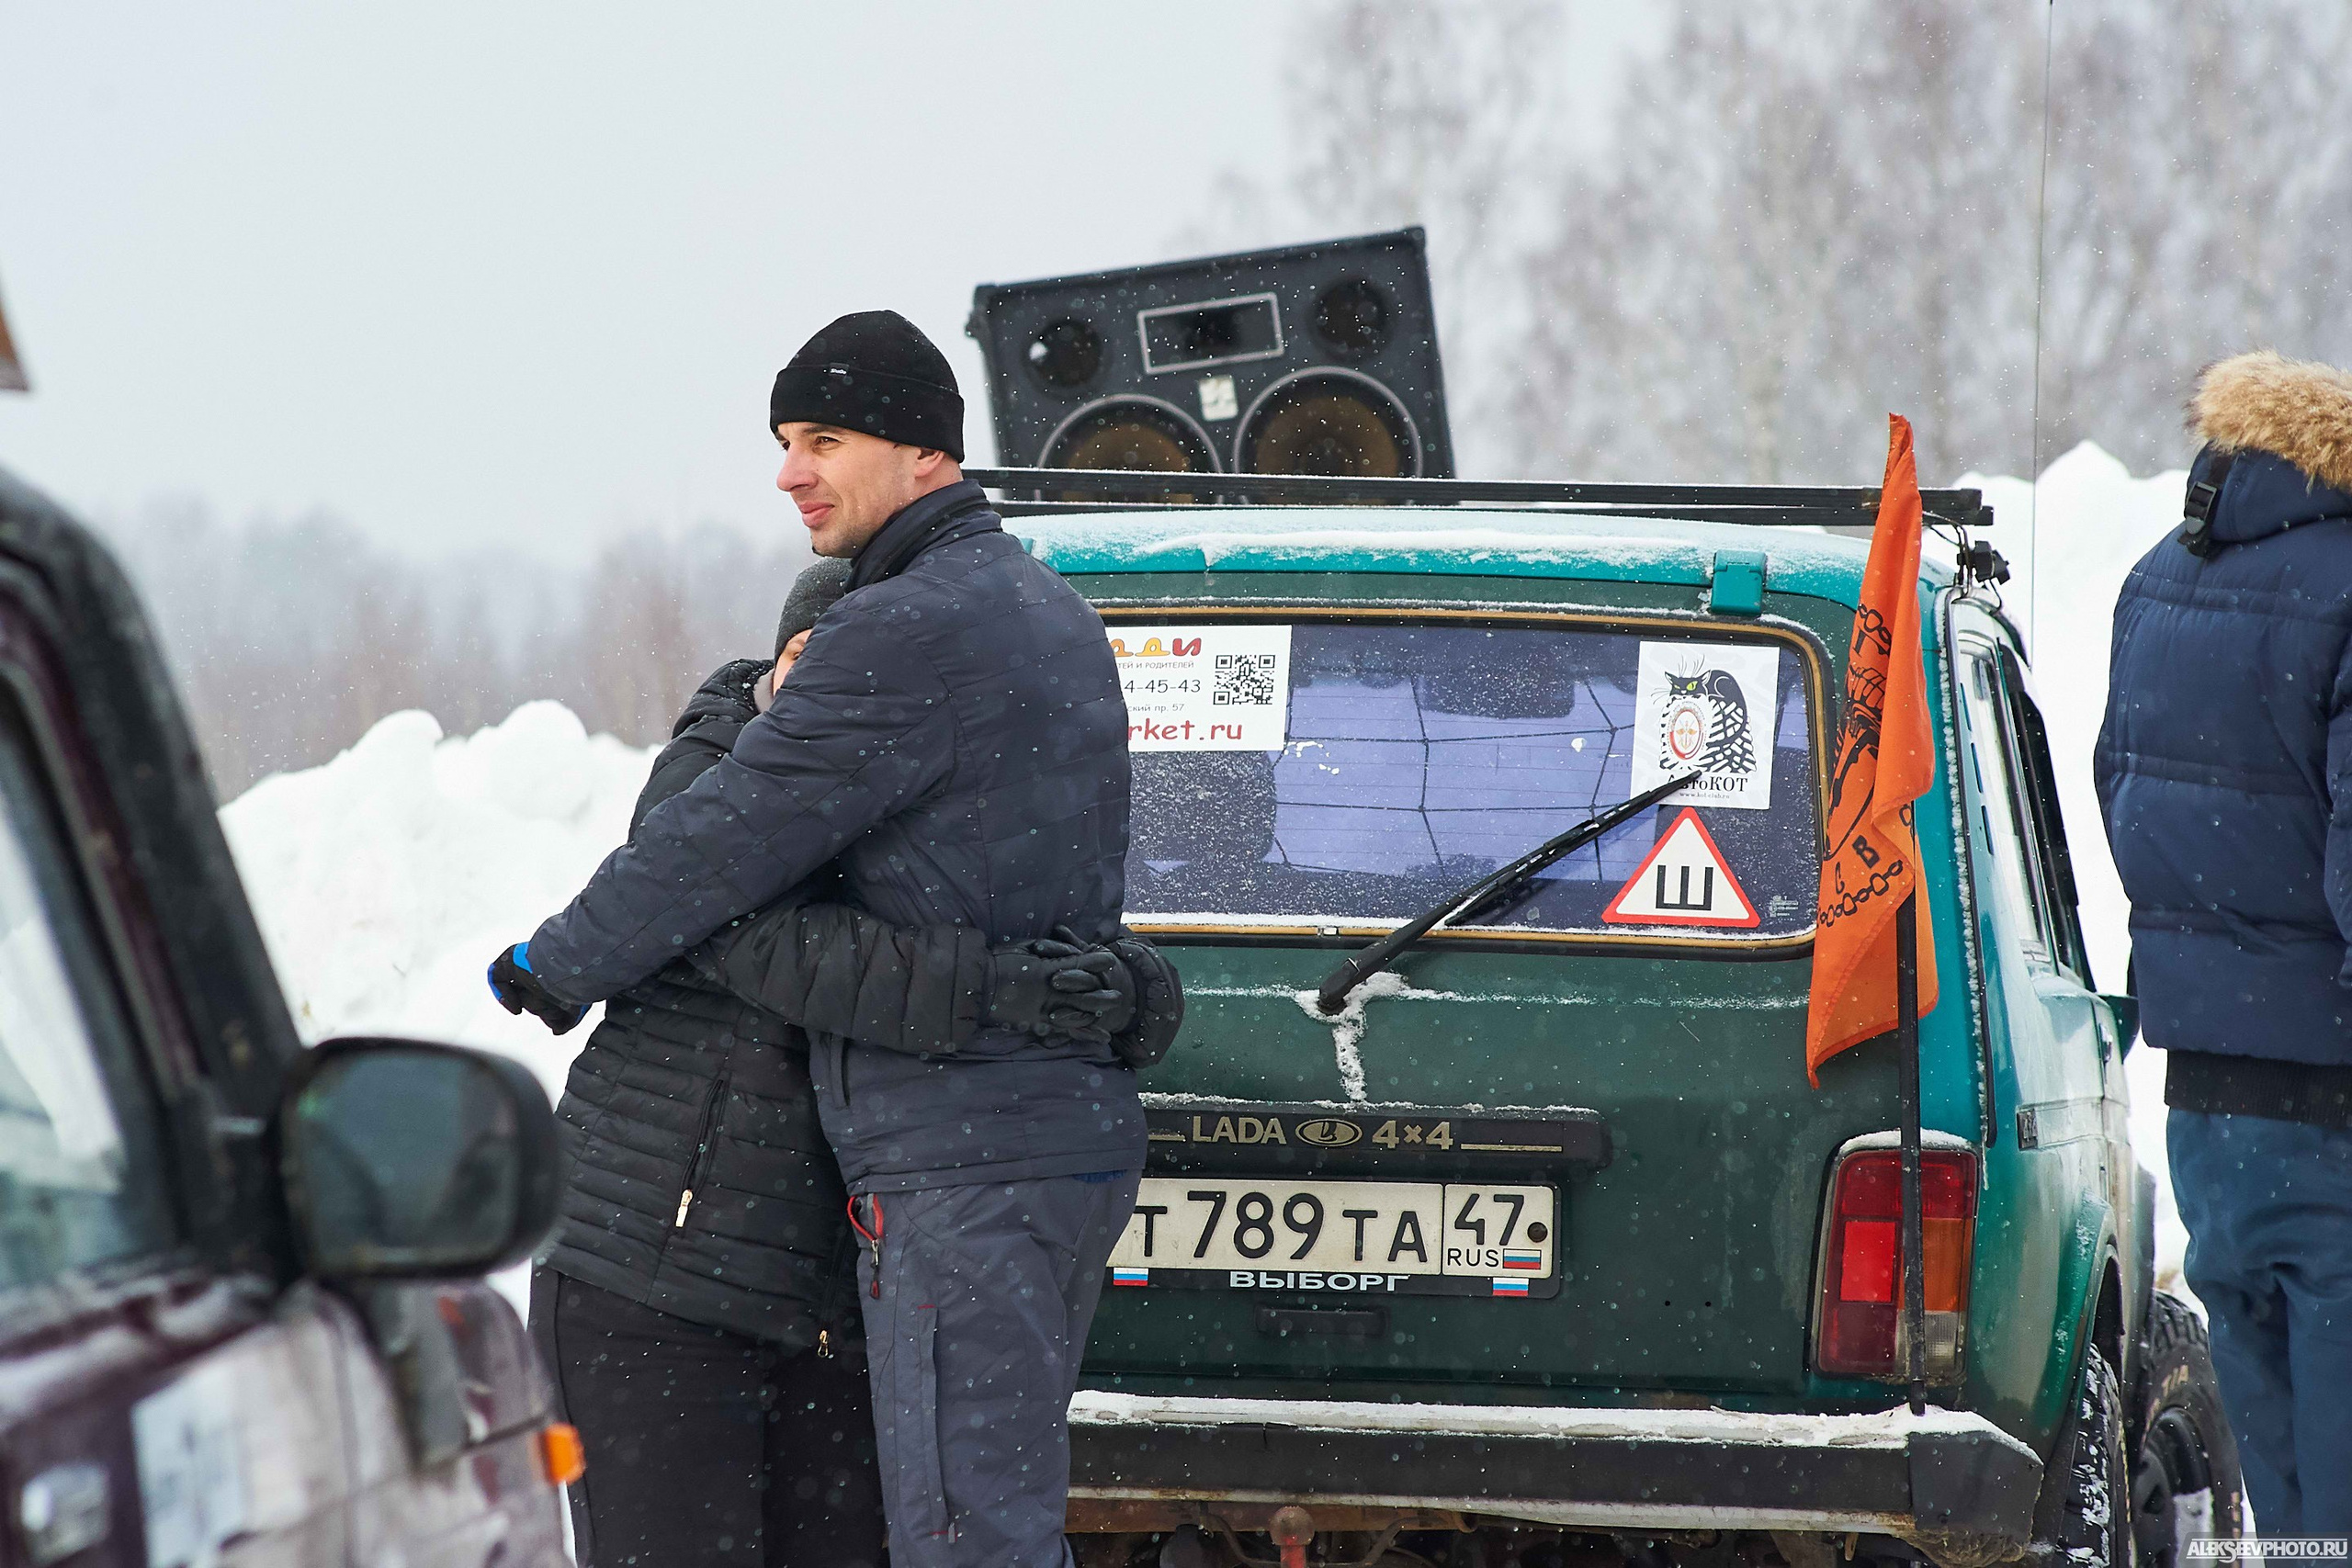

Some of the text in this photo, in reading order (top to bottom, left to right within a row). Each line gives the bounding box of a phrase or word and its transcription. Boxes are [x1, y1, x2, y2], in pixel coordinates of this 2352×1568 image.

[1145, 660, 1194, 670] РОДИТЕЛЕЙ
[1124, 679, 1201, 694] 4-45-43
[1154, 705, 1169, 713] пр.
[1656, 864, 1713, 911] Ш
[1193, 1116, 1286, 1145] LADA
[1454, 1193, 1525, 1247] 47
[1447, 1247, 1499, 1268] RUS
[1229, 1270, 1410, 1292] ВЫБОРГ
